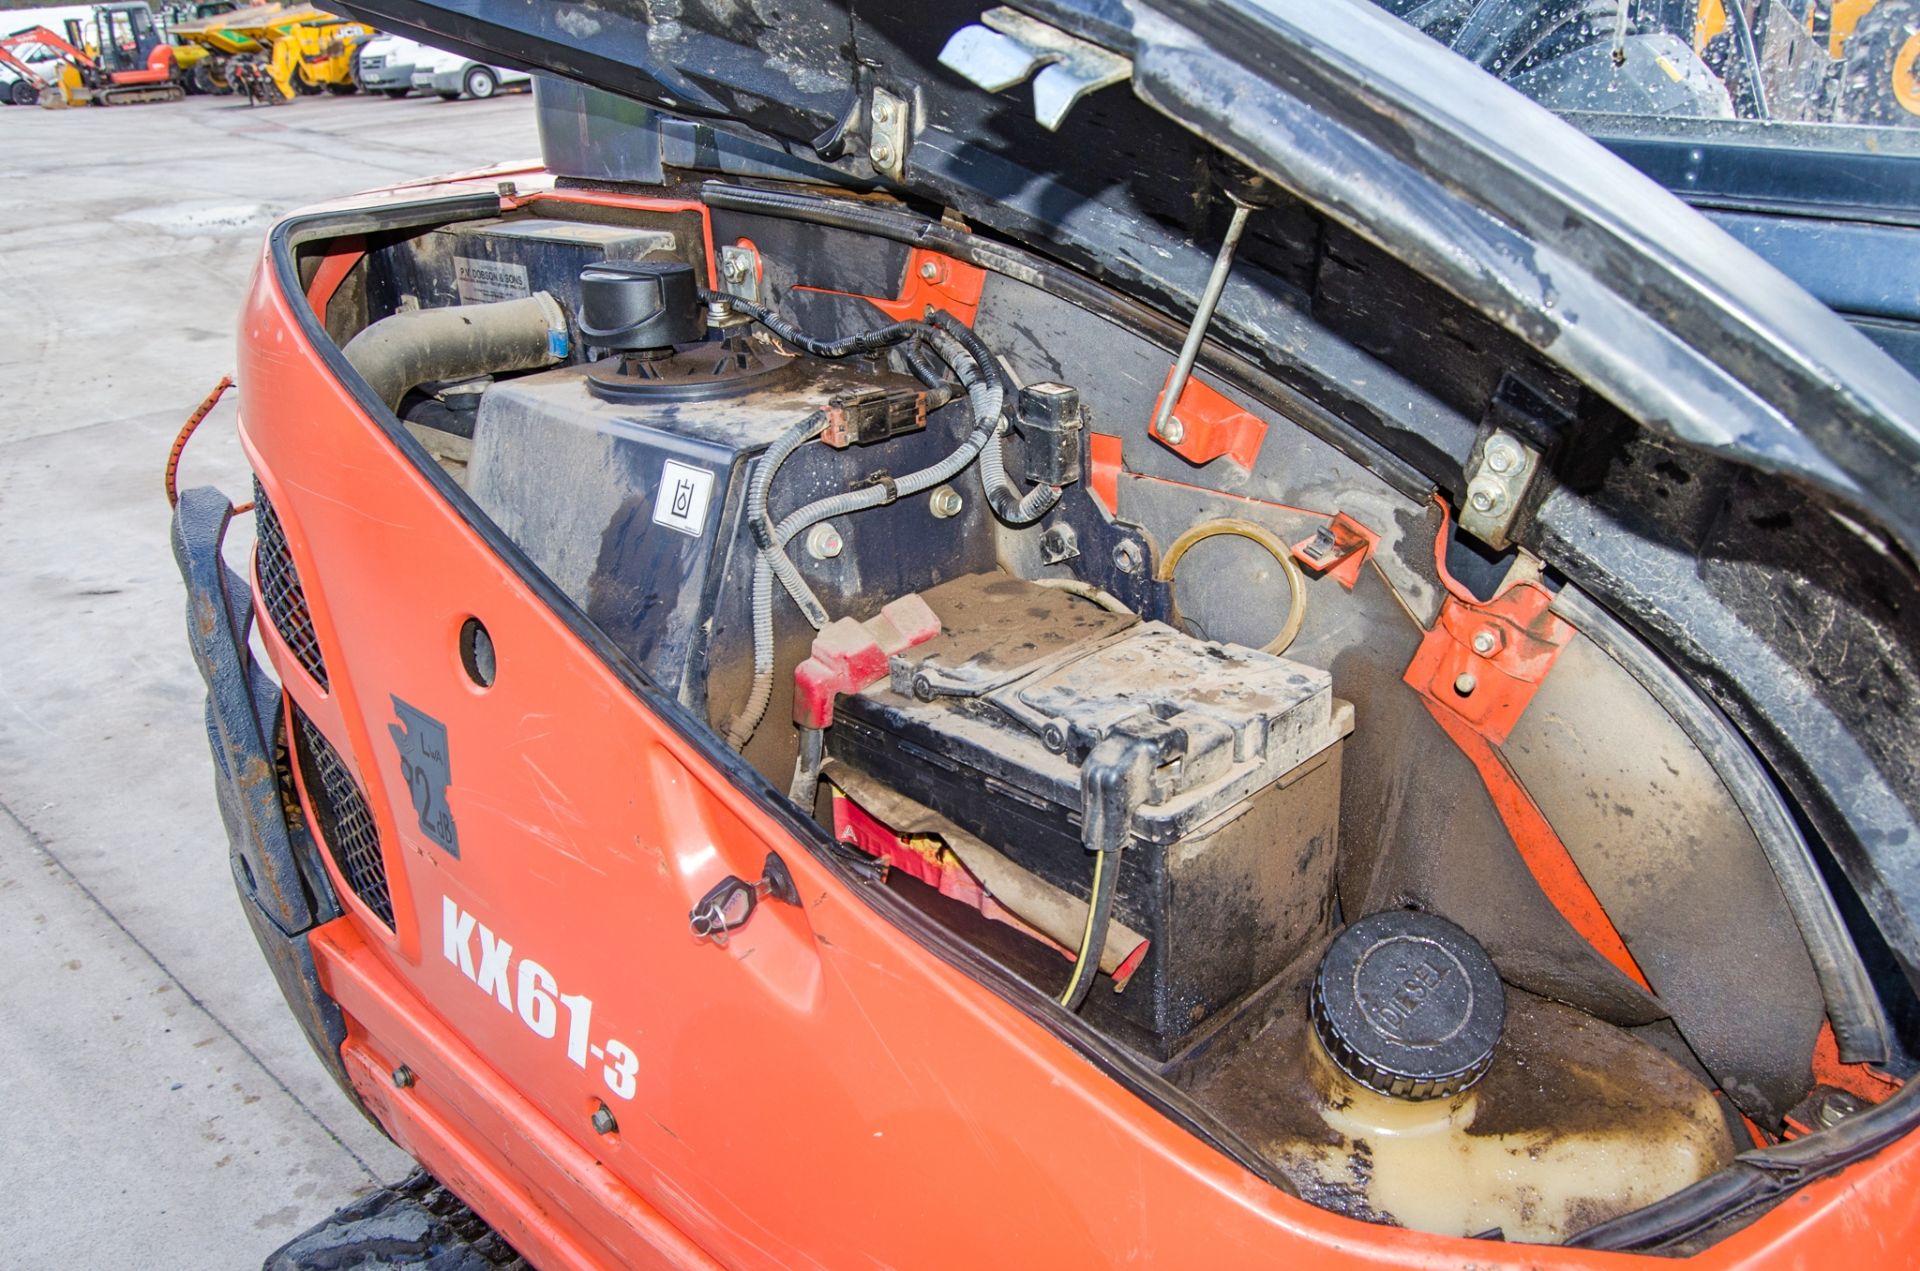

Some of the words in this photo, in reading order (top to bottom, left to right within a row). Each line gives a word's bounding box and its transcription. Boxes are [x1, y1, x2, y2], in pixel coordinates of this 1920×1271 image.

[337, 26, 364, 38] JCB
[472, 269, 498, 281] DOBSON
[505, 274, 523, 286] SONS
[437, 810, 453, 844] dB
[443, 894, 639, 1100] KX61-3
[1378, 961, 1451, 1031] DIESEL
